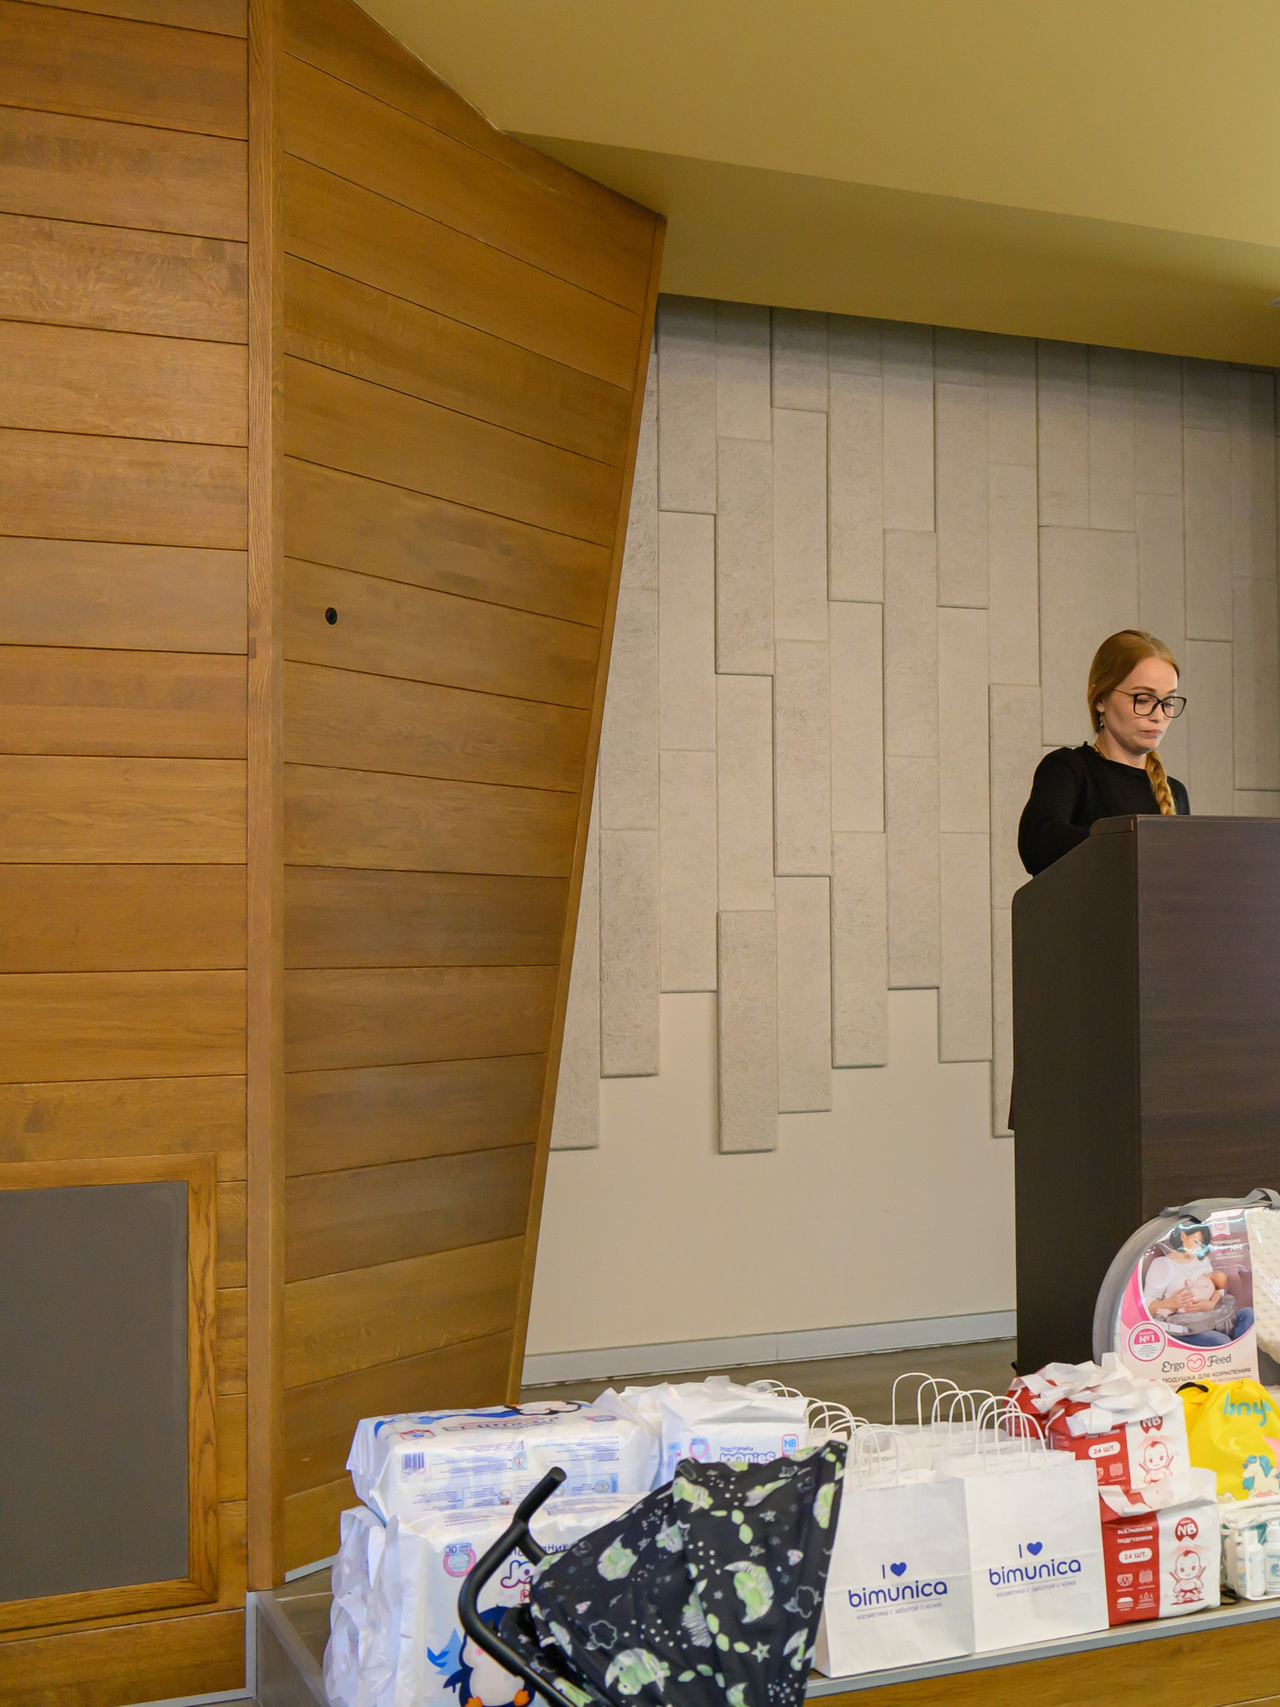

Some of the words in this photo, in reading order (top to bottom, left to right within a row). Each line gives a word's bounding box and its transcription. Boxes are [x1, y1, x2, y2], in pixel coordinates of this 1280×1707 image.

[1161, 1361, 1185, 1373] Ergo
[1206, 1354, 1232, 1368] Feed
[1212, 1367, 1252, 1377] КОРМЛЕНИЯ
[784, 1438, 797, 1447] NB
[1177, 1523, 1198, 1536] NB
[1124, 1552, 1133, 1560] 24
[988, 1558, 1082, 1586] bimunica
[848, 1580, 948, 1608] bimunica
